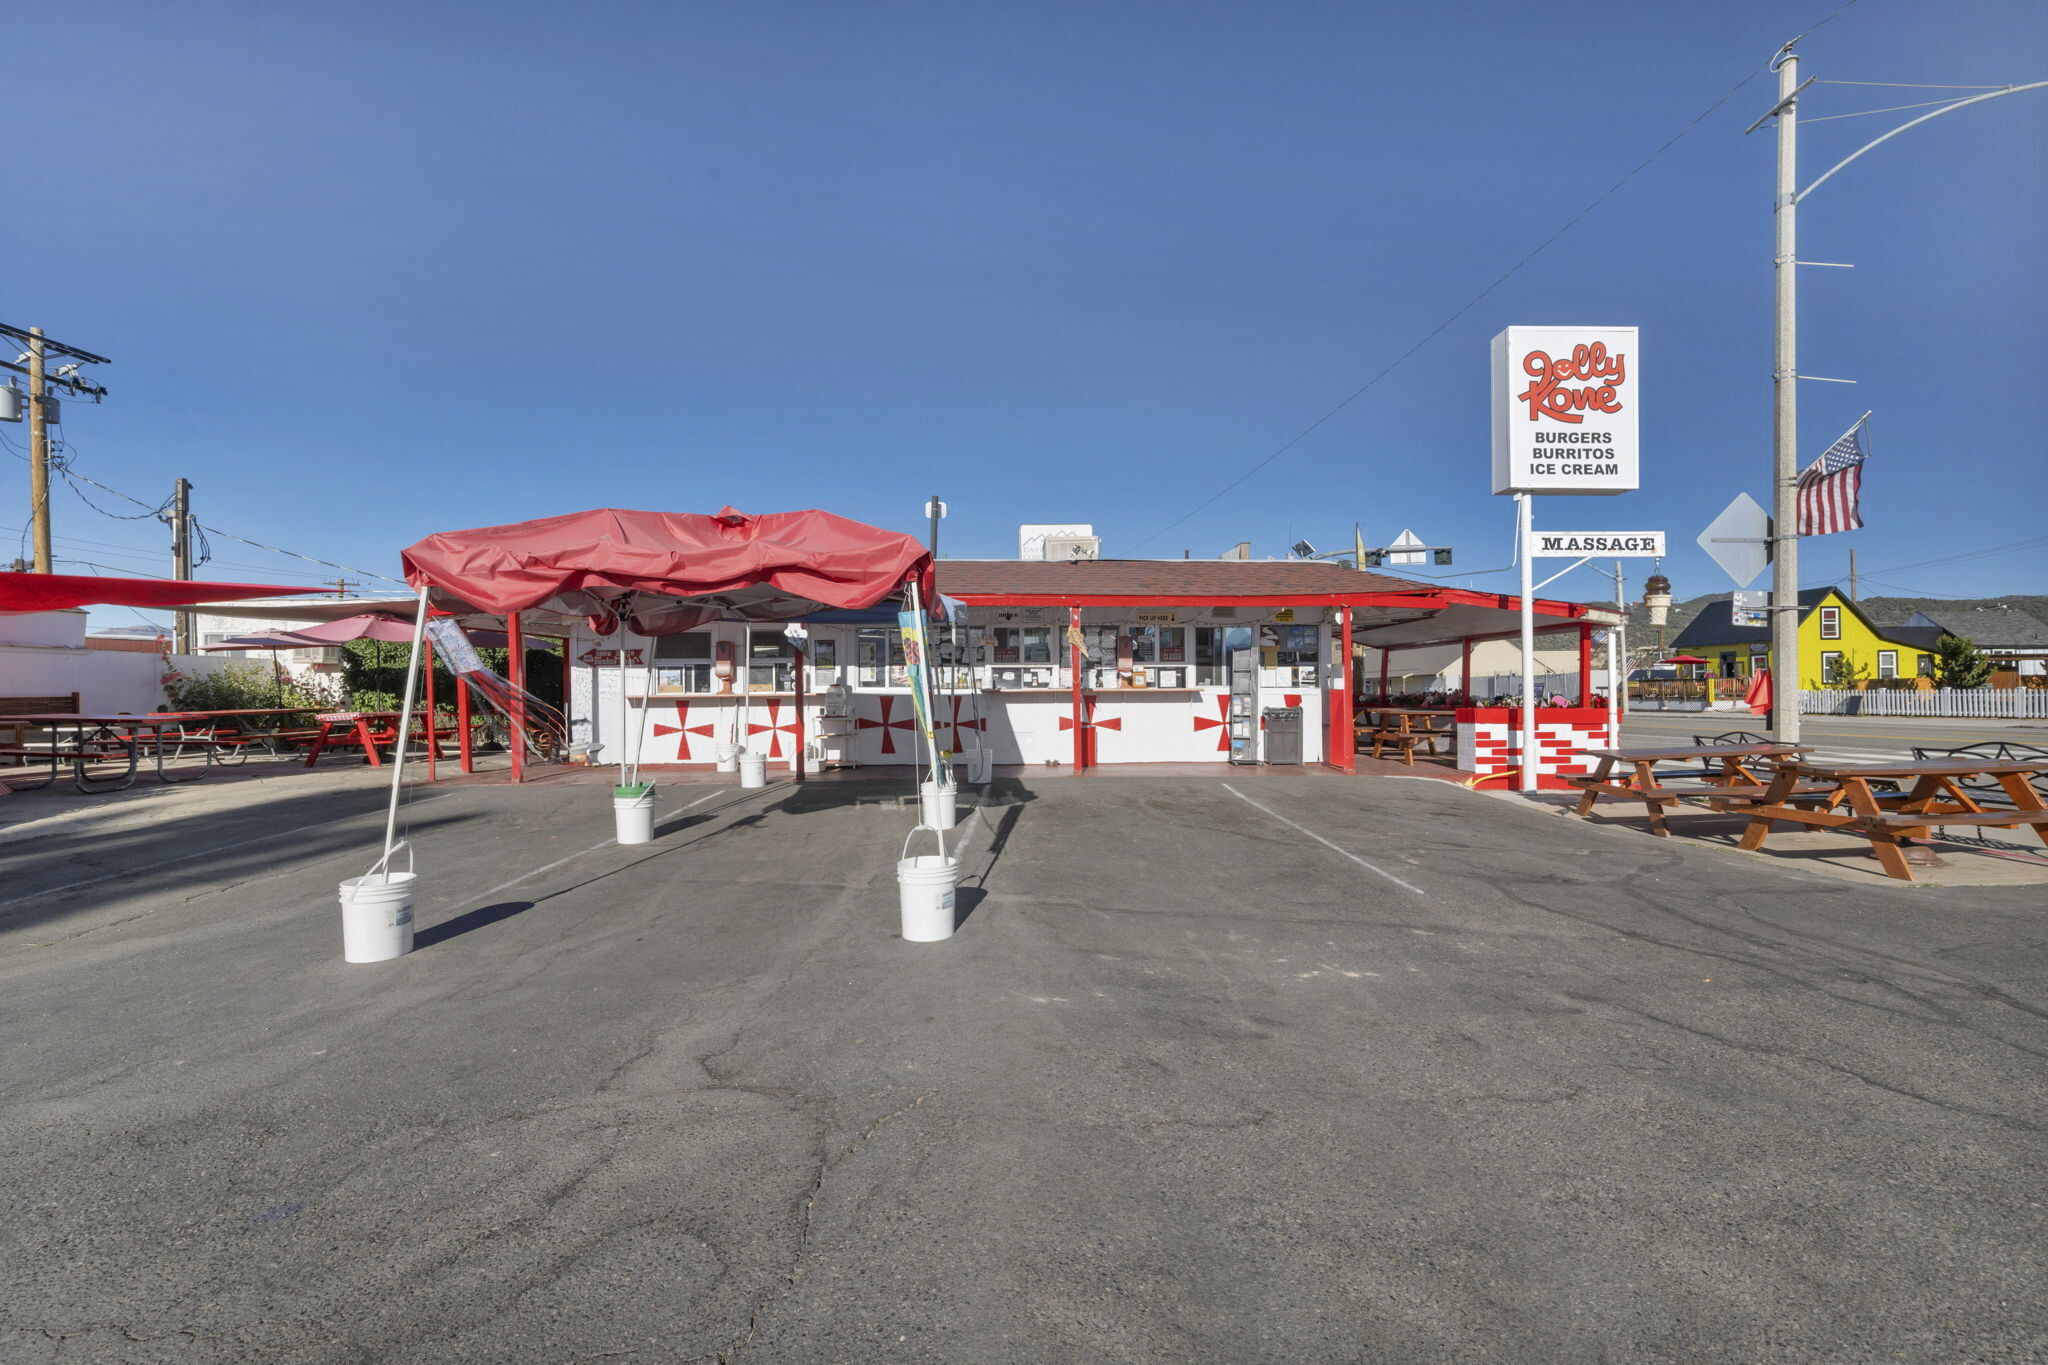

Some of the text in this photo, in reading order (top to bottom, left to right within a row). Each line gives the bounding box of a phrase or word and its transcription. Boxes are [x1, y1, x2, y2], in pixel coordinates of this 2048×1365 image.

[1523, 341, 1625, 386] Jolly
[1517, 379, 1623, 424] Kone
[1535, 432, 1612, 444] BURGERS
[1532, 447, 1615, 460] BURRITOS
[1530, 463, 1618, 475] ICE CREAM
[1541, 537, 1656, 551] MASSAGE
[1164, 652, 1182, 660] CLOSED
